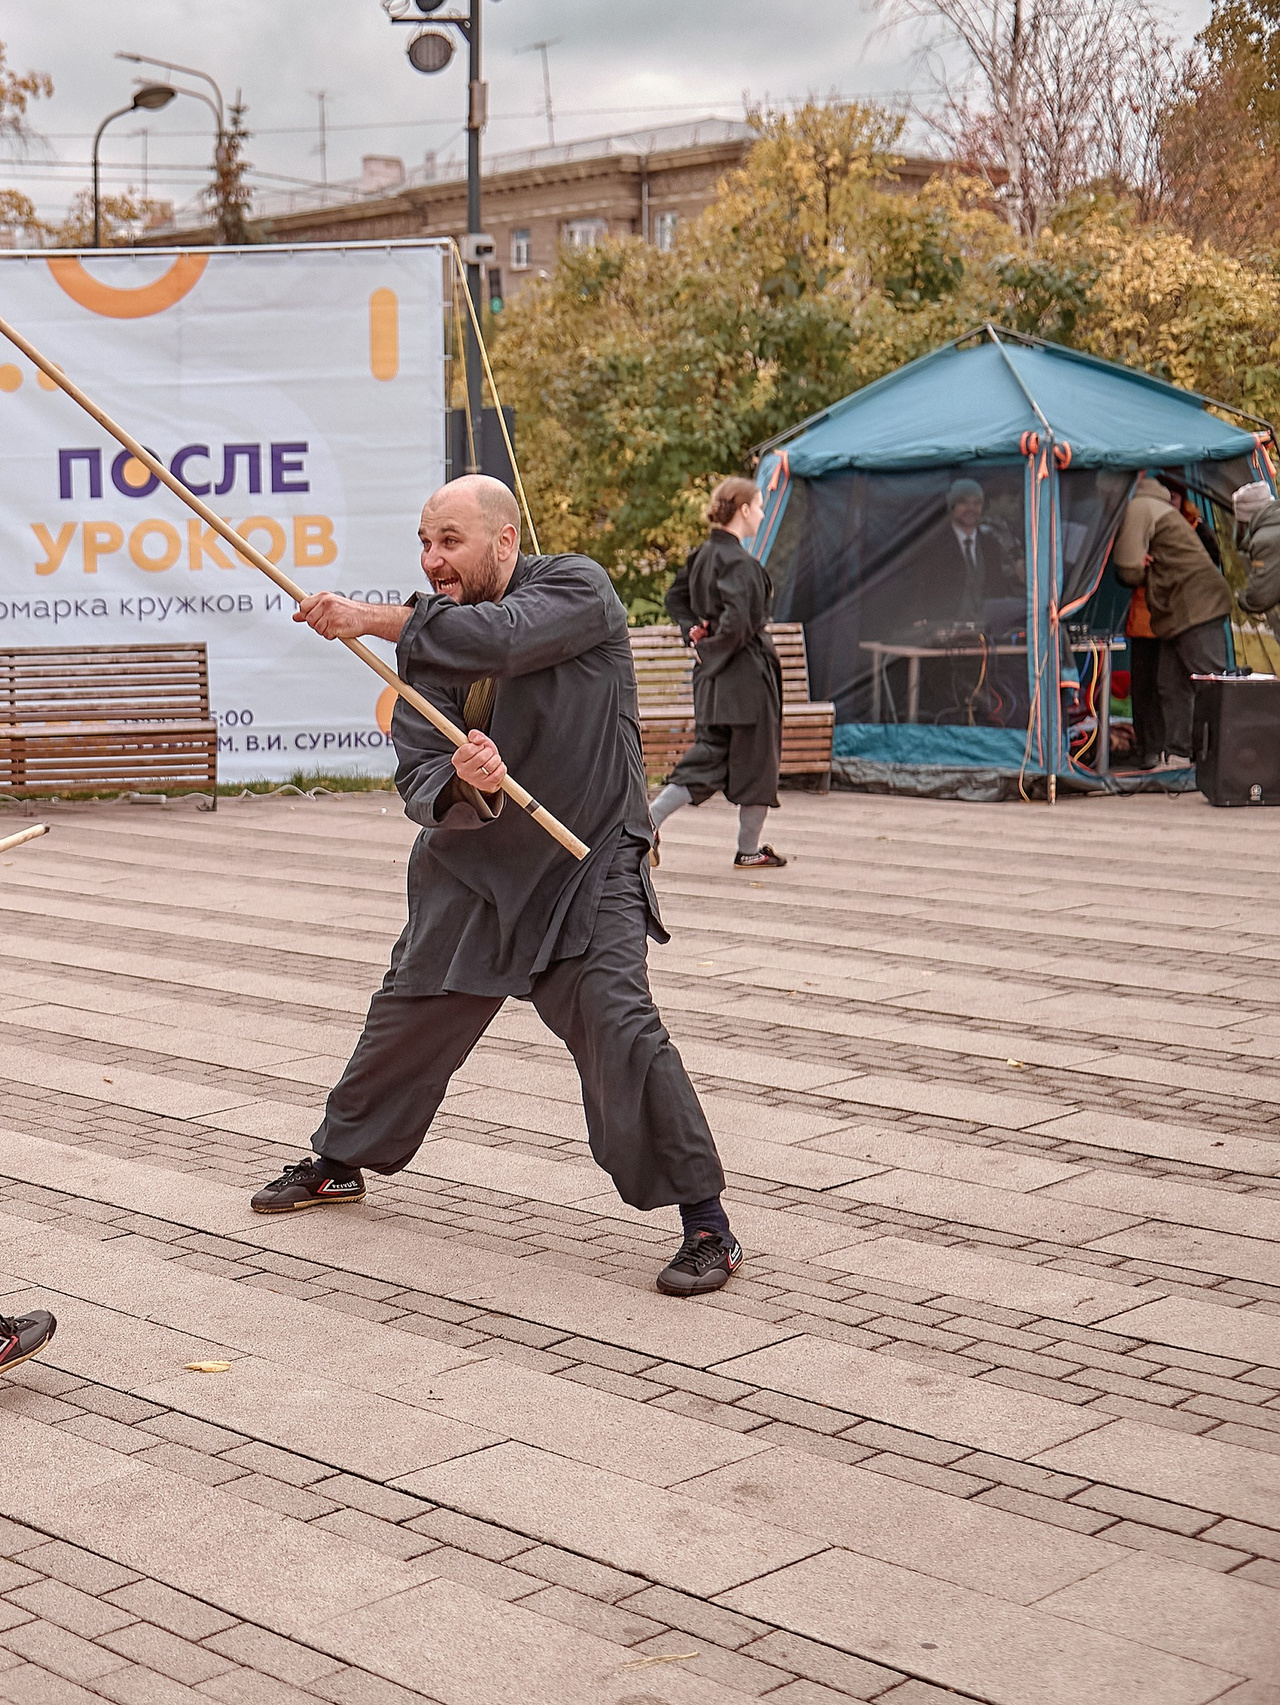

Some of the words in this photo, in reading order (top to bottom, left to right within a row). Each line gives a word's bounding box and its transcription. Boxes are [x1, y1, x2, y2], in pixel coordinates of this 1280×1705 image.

[58, 441, 311, 500] ПОСЛЕ
[30, 513, 339, 577] УРОКОВ
[120, 592, 255, 622] кружков
[265, 592, 283, 612] и
[246, 734, 288, 752] В.И.
